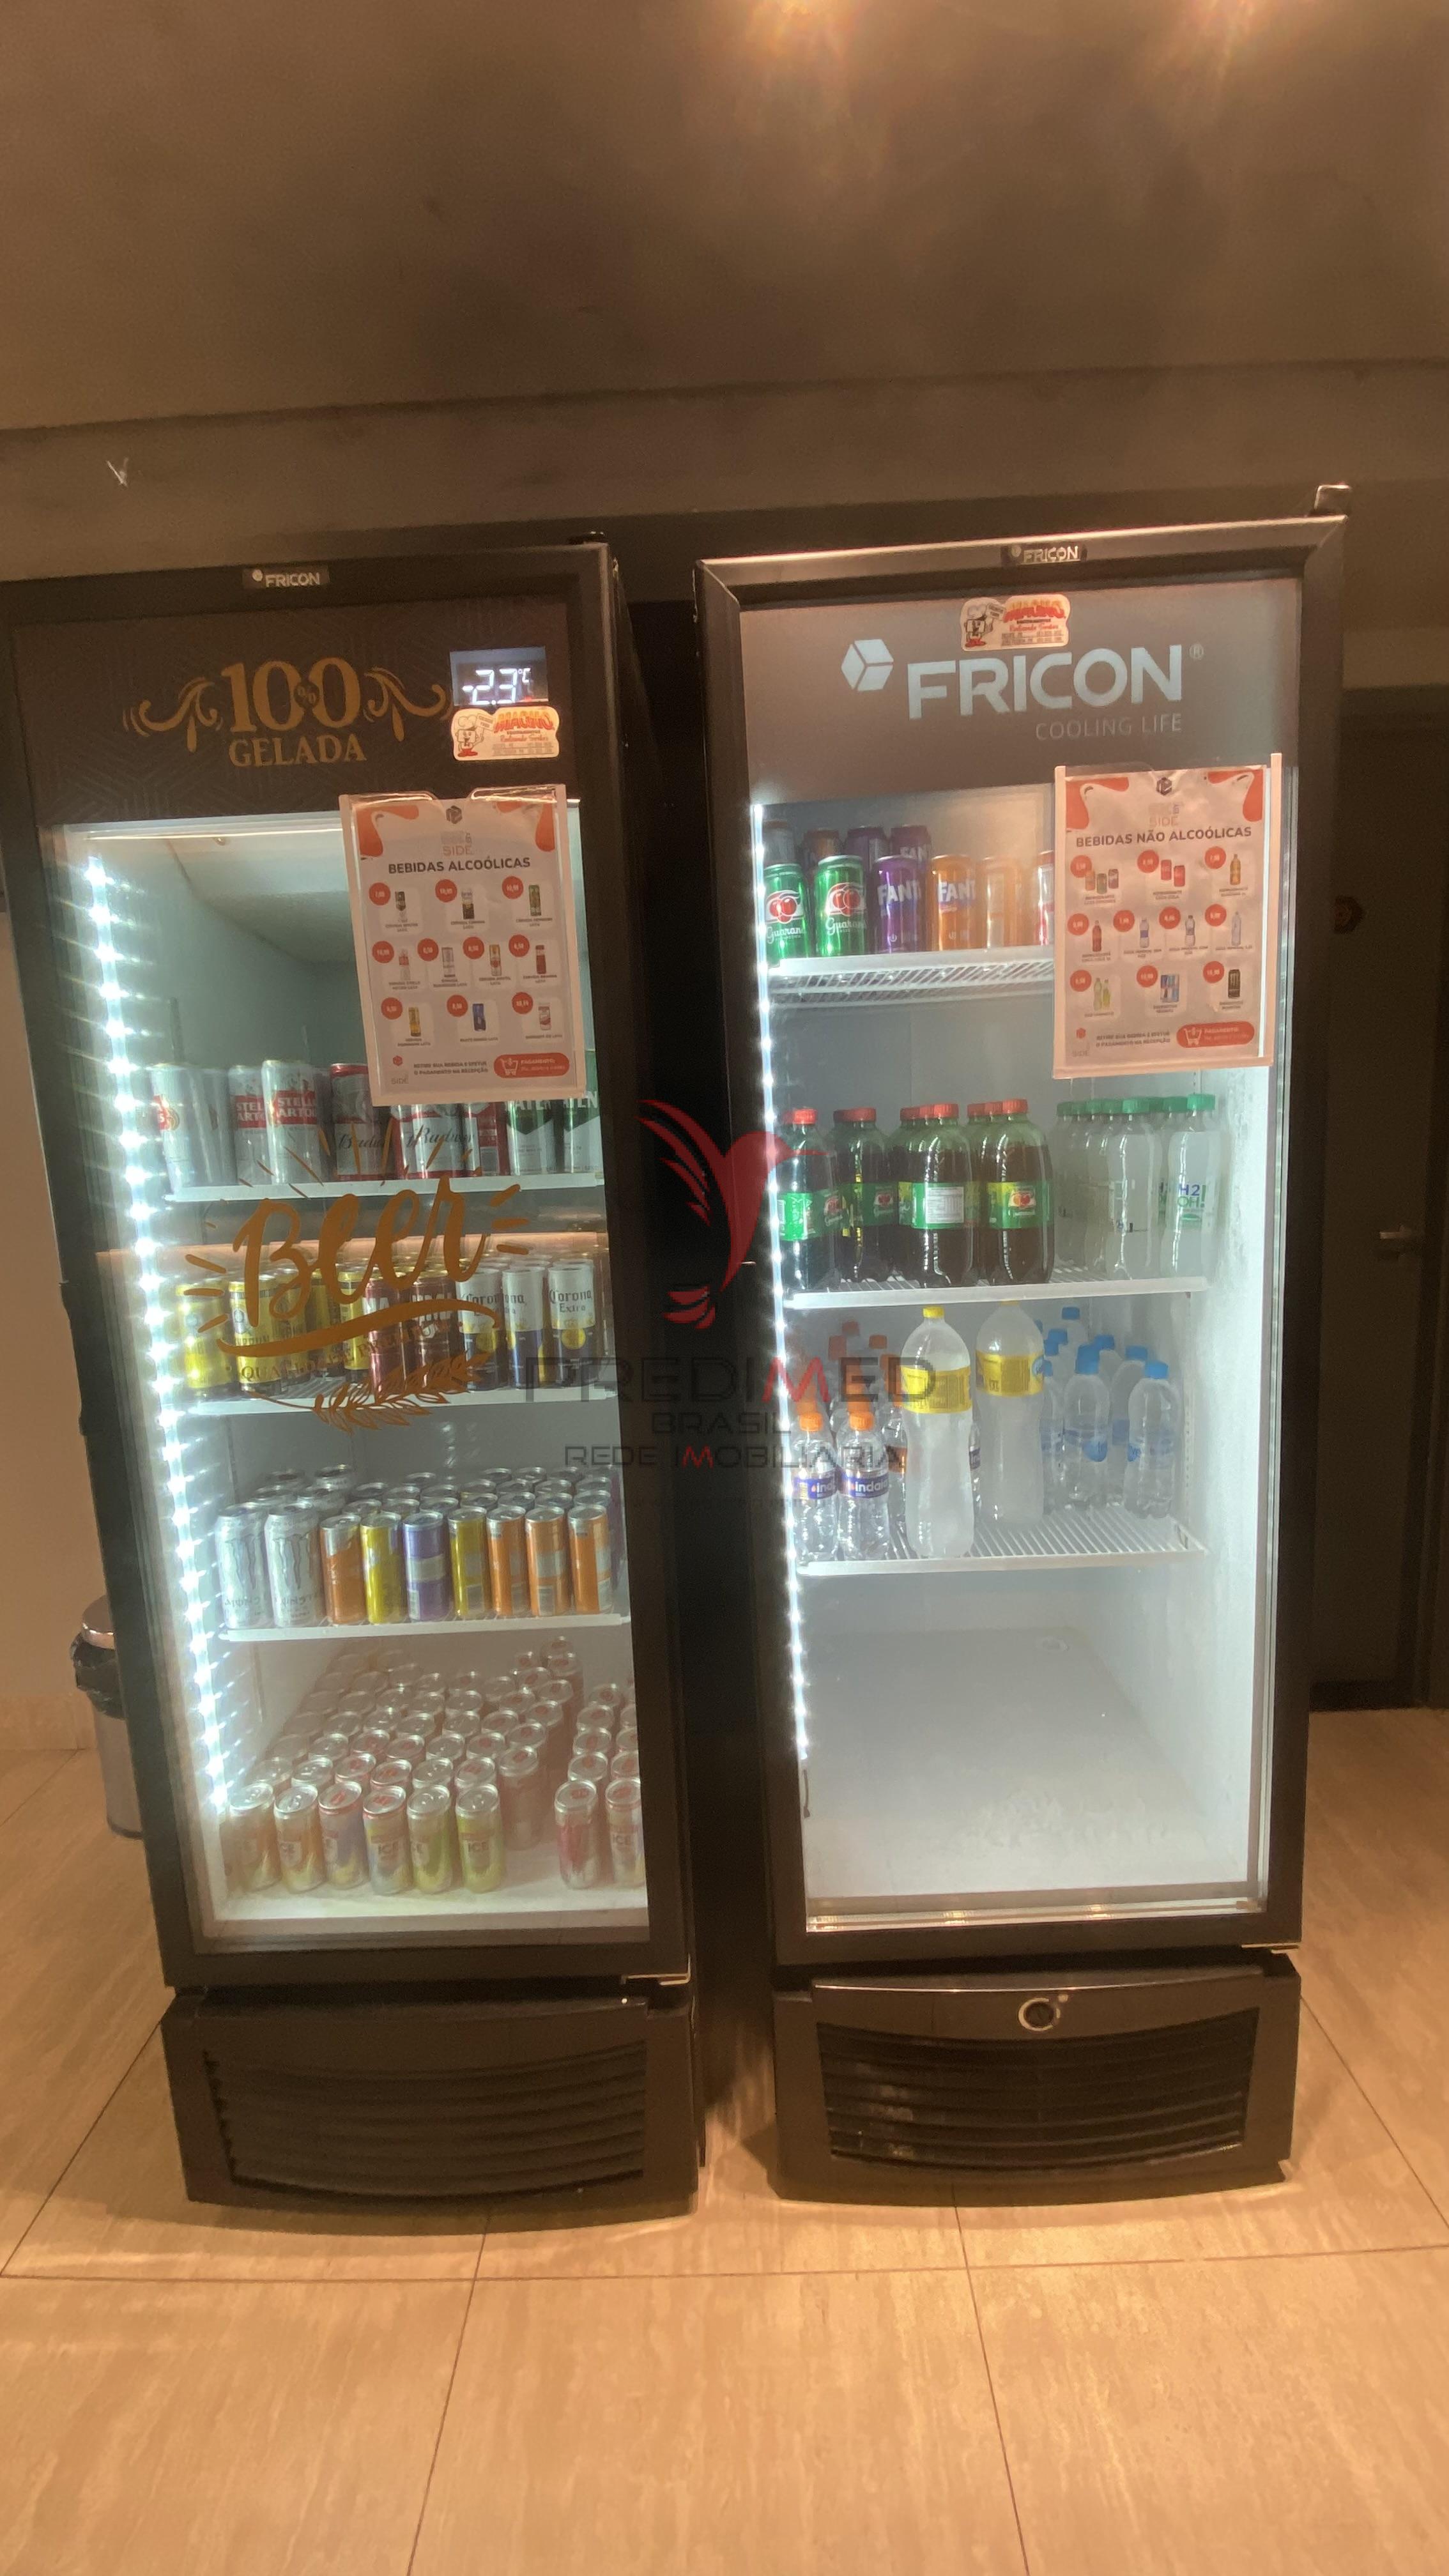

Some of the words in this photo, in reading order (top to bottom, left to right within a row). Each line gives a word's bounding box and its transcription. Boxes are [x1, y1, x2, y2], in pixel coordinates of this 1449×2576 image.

[1023, 545, 1081, 563] FRICON
[264, 572, 321, 588] FRICON
[907, 644, 1183, 720] FRICON
[220, 656, 362, 733] 100
[1036, 720, 1132, 742] COOLING
[1142, 712, 1183, 734] LIFE
[228, 733, 367, 767] GELADA
[1076, 833, 1133, 848] BEBIDAS
[1137, 830, 1165, 843] NÃO
[1169, 826, 1252, 841] ALCOÓLICAS
[388, 861, 445, 875] BEBIDAS
[448, 855, 531, 873] ALCOÓLICAS
[937, 879, 976, 903] FANT
[233, 1176, 488, 1328] Beer
[549, 1289, 592, 1305] Corona
